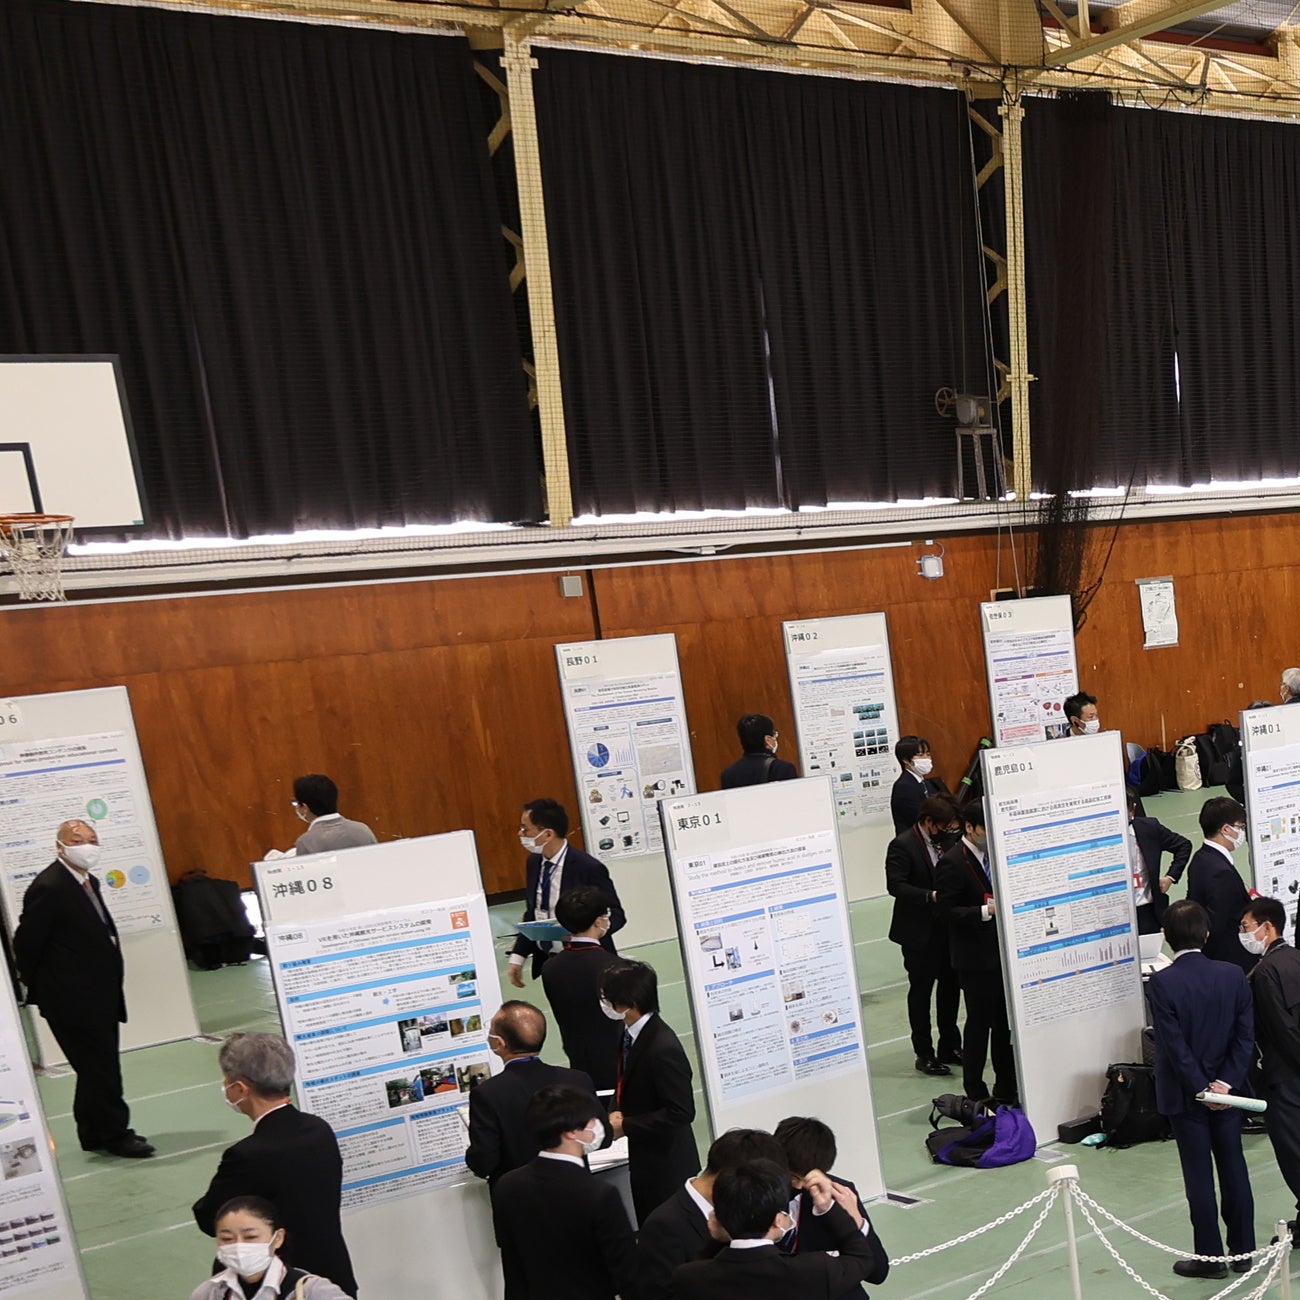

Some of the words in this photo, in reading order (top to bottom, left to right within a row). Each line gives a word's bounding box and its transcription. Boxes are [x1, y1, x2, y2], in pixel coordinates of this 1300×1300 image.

[566, 655, 599, 667] 長野０１
[1250, 723, 1281, 736] 沖縄０１
[994, 762, 1034, 777] 鹿児島０１
[675, 811, 722, 832] 東京０１
[271, 875, 335, 899] 沖縄０８
